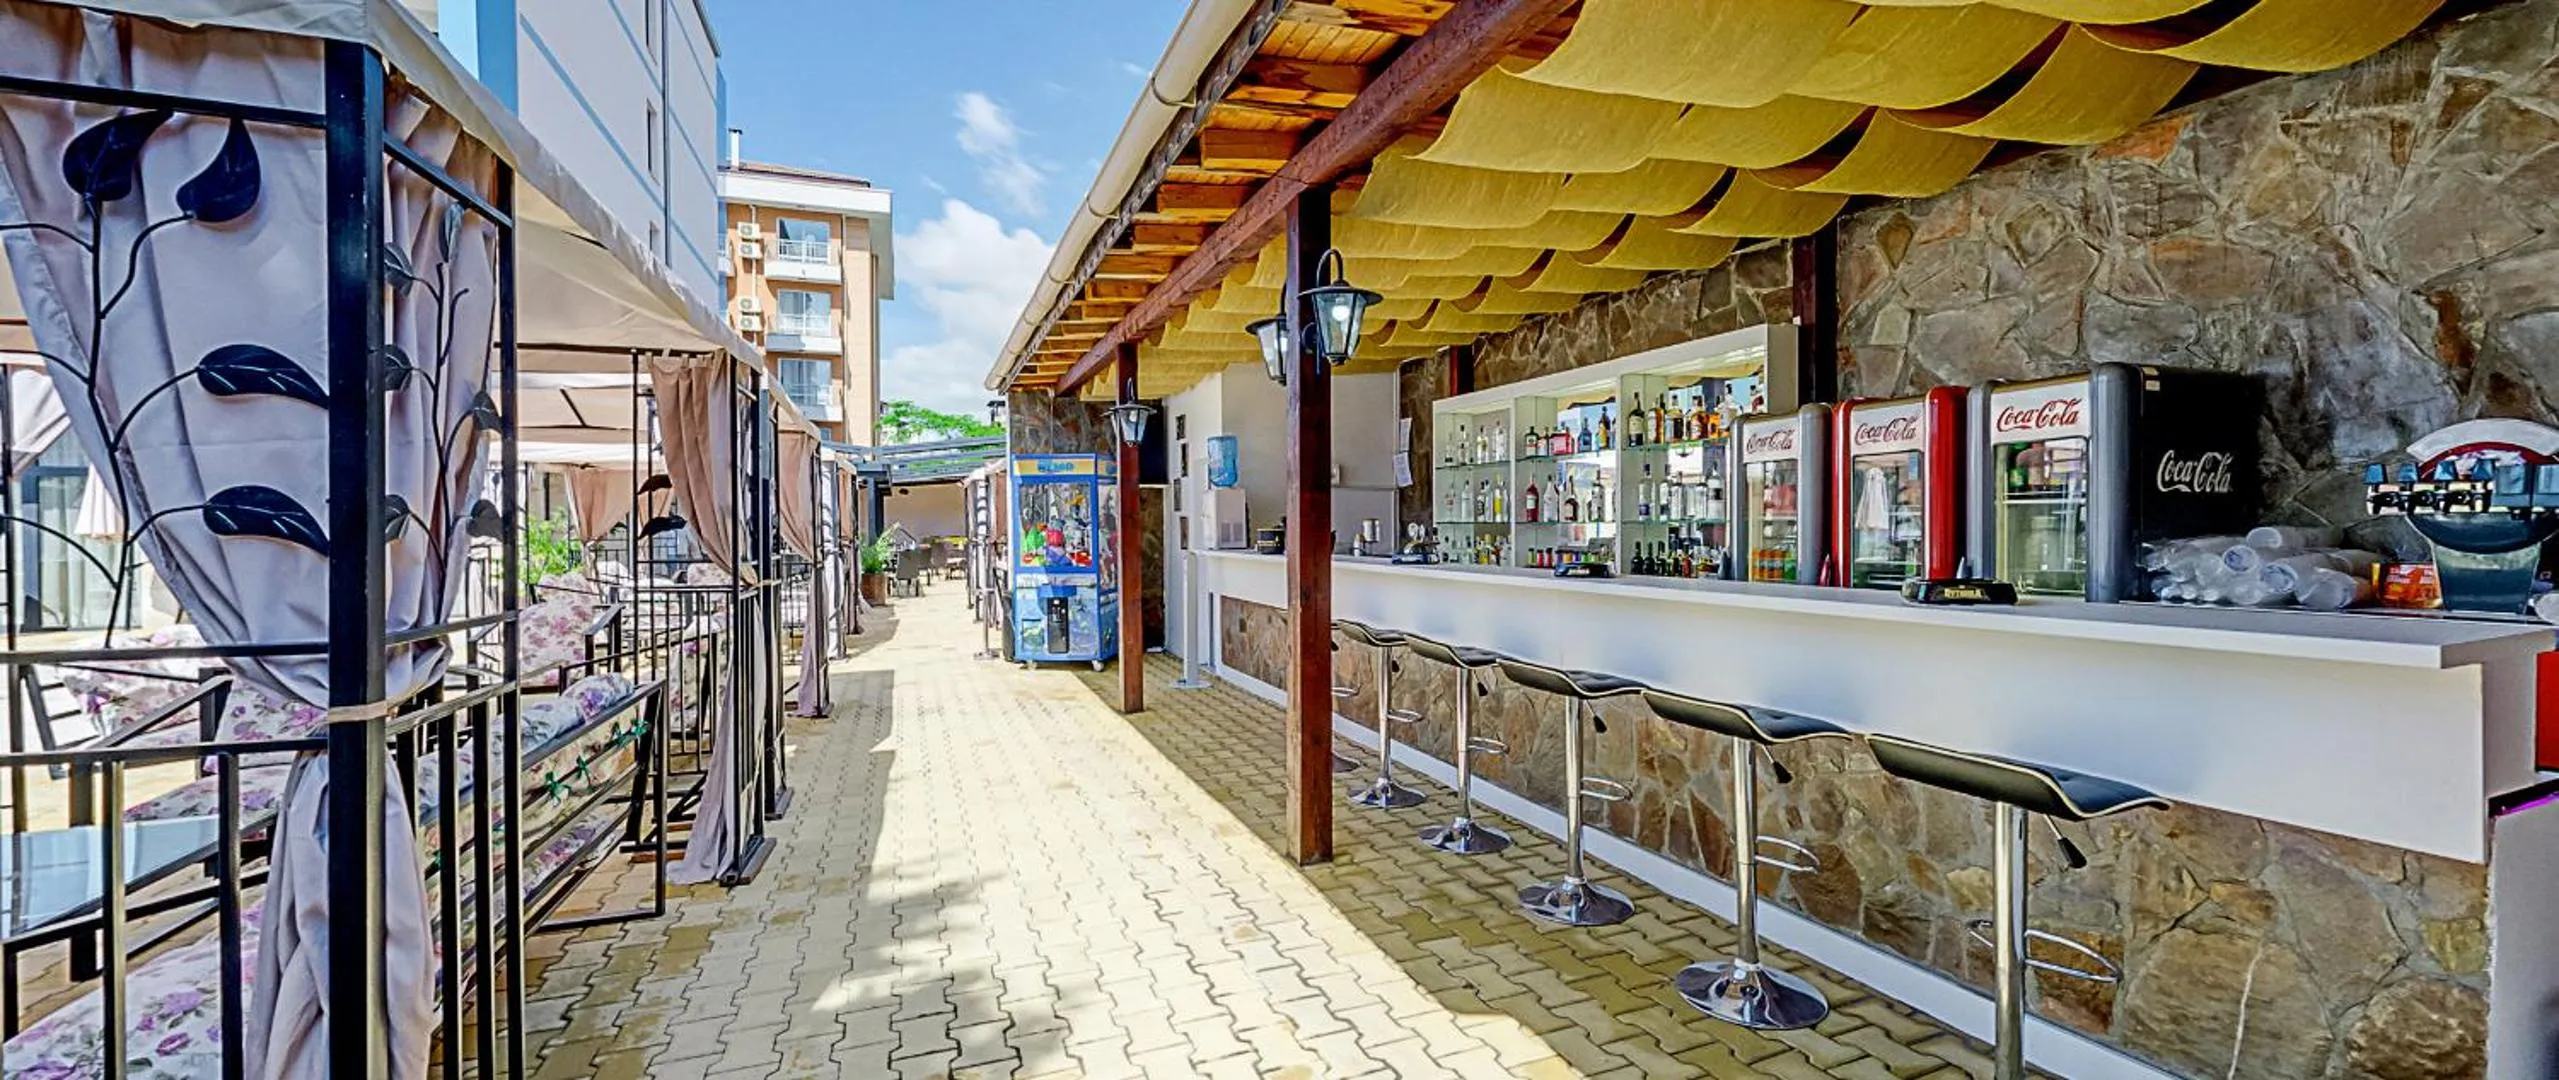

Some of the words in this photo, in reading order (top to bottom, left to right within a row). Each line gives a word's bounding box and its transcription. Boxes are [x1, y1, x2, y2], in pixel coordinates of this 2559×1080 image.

[1855, 416, 1918, 446] Coca-Cola
[1997, 398, 2083, 433] Coca-Cola
[2156, 450, 2233, 493] Coca-Cola
